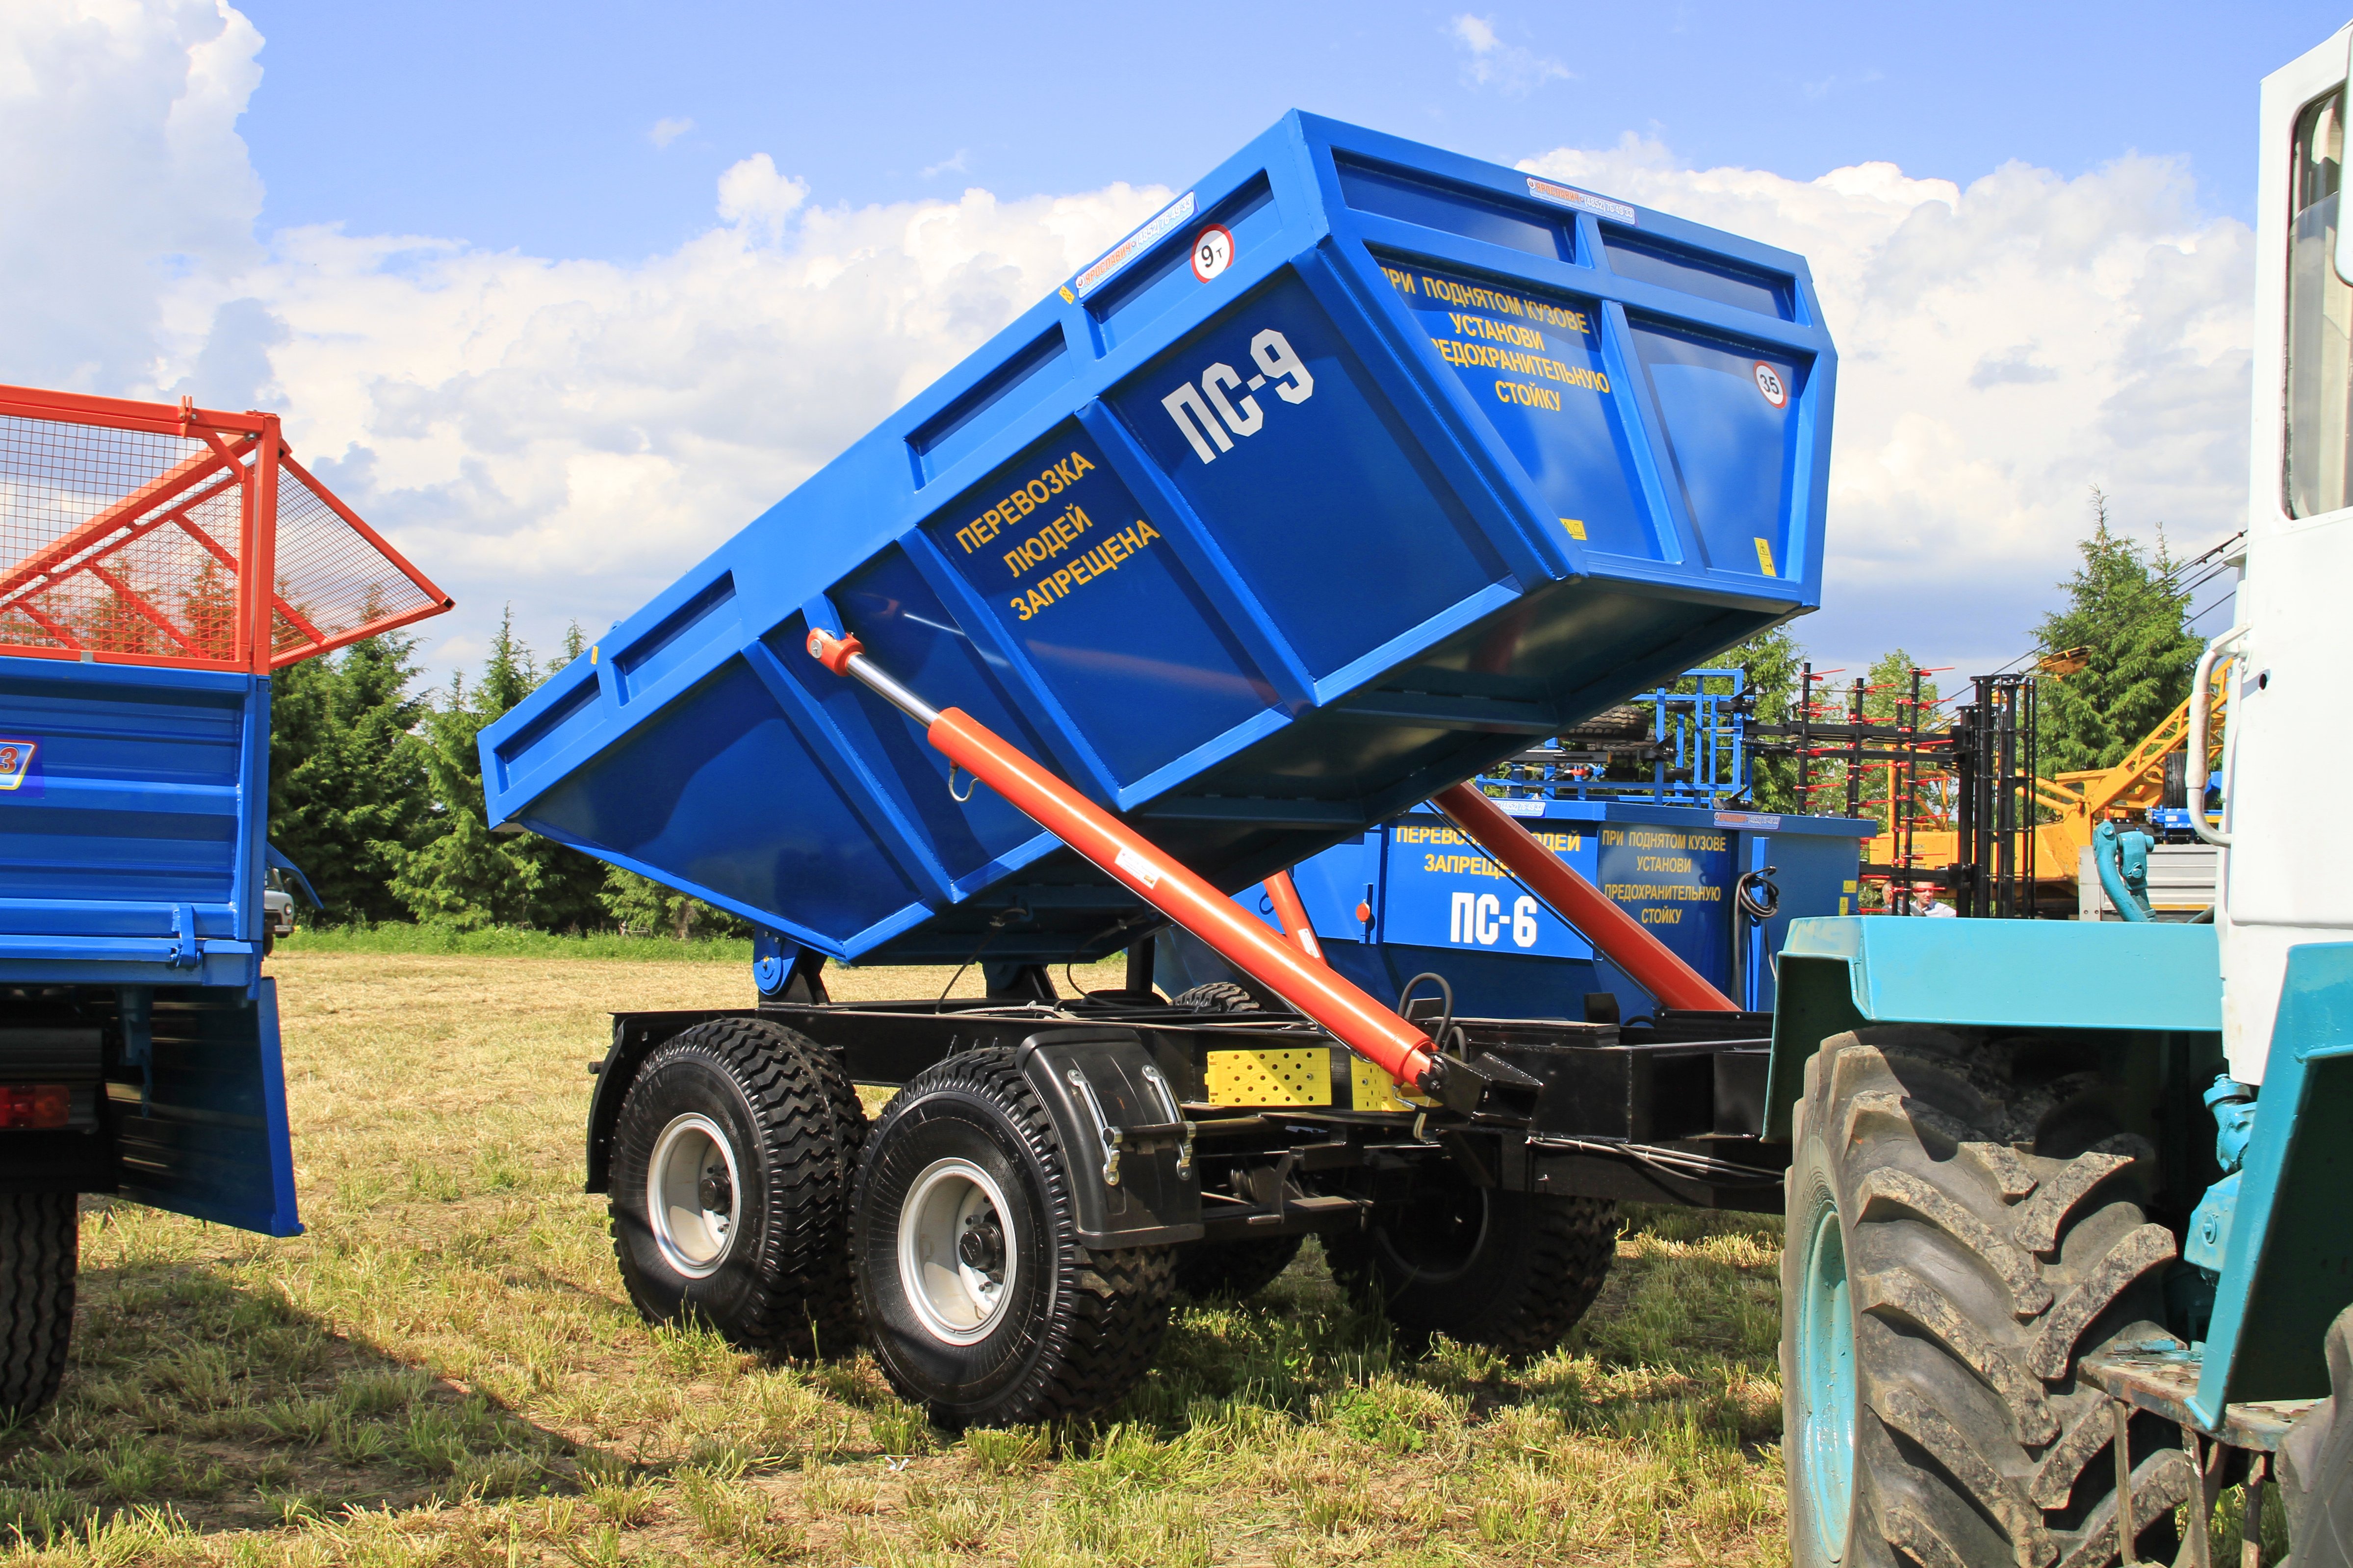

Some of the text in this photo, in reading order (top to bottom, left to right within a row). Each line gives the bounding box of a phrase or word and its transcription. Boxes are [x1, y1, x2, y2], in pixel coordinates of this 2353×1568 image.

[1536, 182, 1581, 204] ЯРОСЛАВИЧ
[1584, 196, 1606, 212] (4852)
[1606, 202, 1633, 218] 76-49-33
[1085, 196, 1192, 284] ЯРОСЛАВИЧ (4852) 76-49-33
[1201, 245, 1214, 268] 9
[1422, 276, 1524, 317] ПОДНЯТОМ
[1524, 299, 1590, 334] КУЗОВЕ
[1448, 312, 1545, 352] УСТАНОВИ
[1430, 337, 1611, 394] ЕДОХРАНИТЕЛЬНУЮ
[1161, 329, 1314, 465] ПС-9
[1494, 380, 1562, 411] СТОЙКУ
[1759, 374, 1780, 395] 35
[955, 451, 1096, 554] ПЕРЕВОЗКА
[1003, 503, 1093, 578] ЛЮДЕЙ
[1009, 519, 1161, 621] ЗАПРЕЩЕНА
[1500, 801, 1519, 811] (4852)
[1396, 826, 1481, 846] ПЕРЕВО
[1602, 829, 1727, 852] ПРИ ПОДНЯТОМ КУЗОВЕ
[1636, 856, 1692, 873] УСТАНОВИ
[1604, 884, 1721, 902] ПРЕДОХРАНИТЕЛЬНУЮ
[1450, 892, 1538, 948] ПС-6
[1641, 906, 1683, 924] СТОЙКУ
